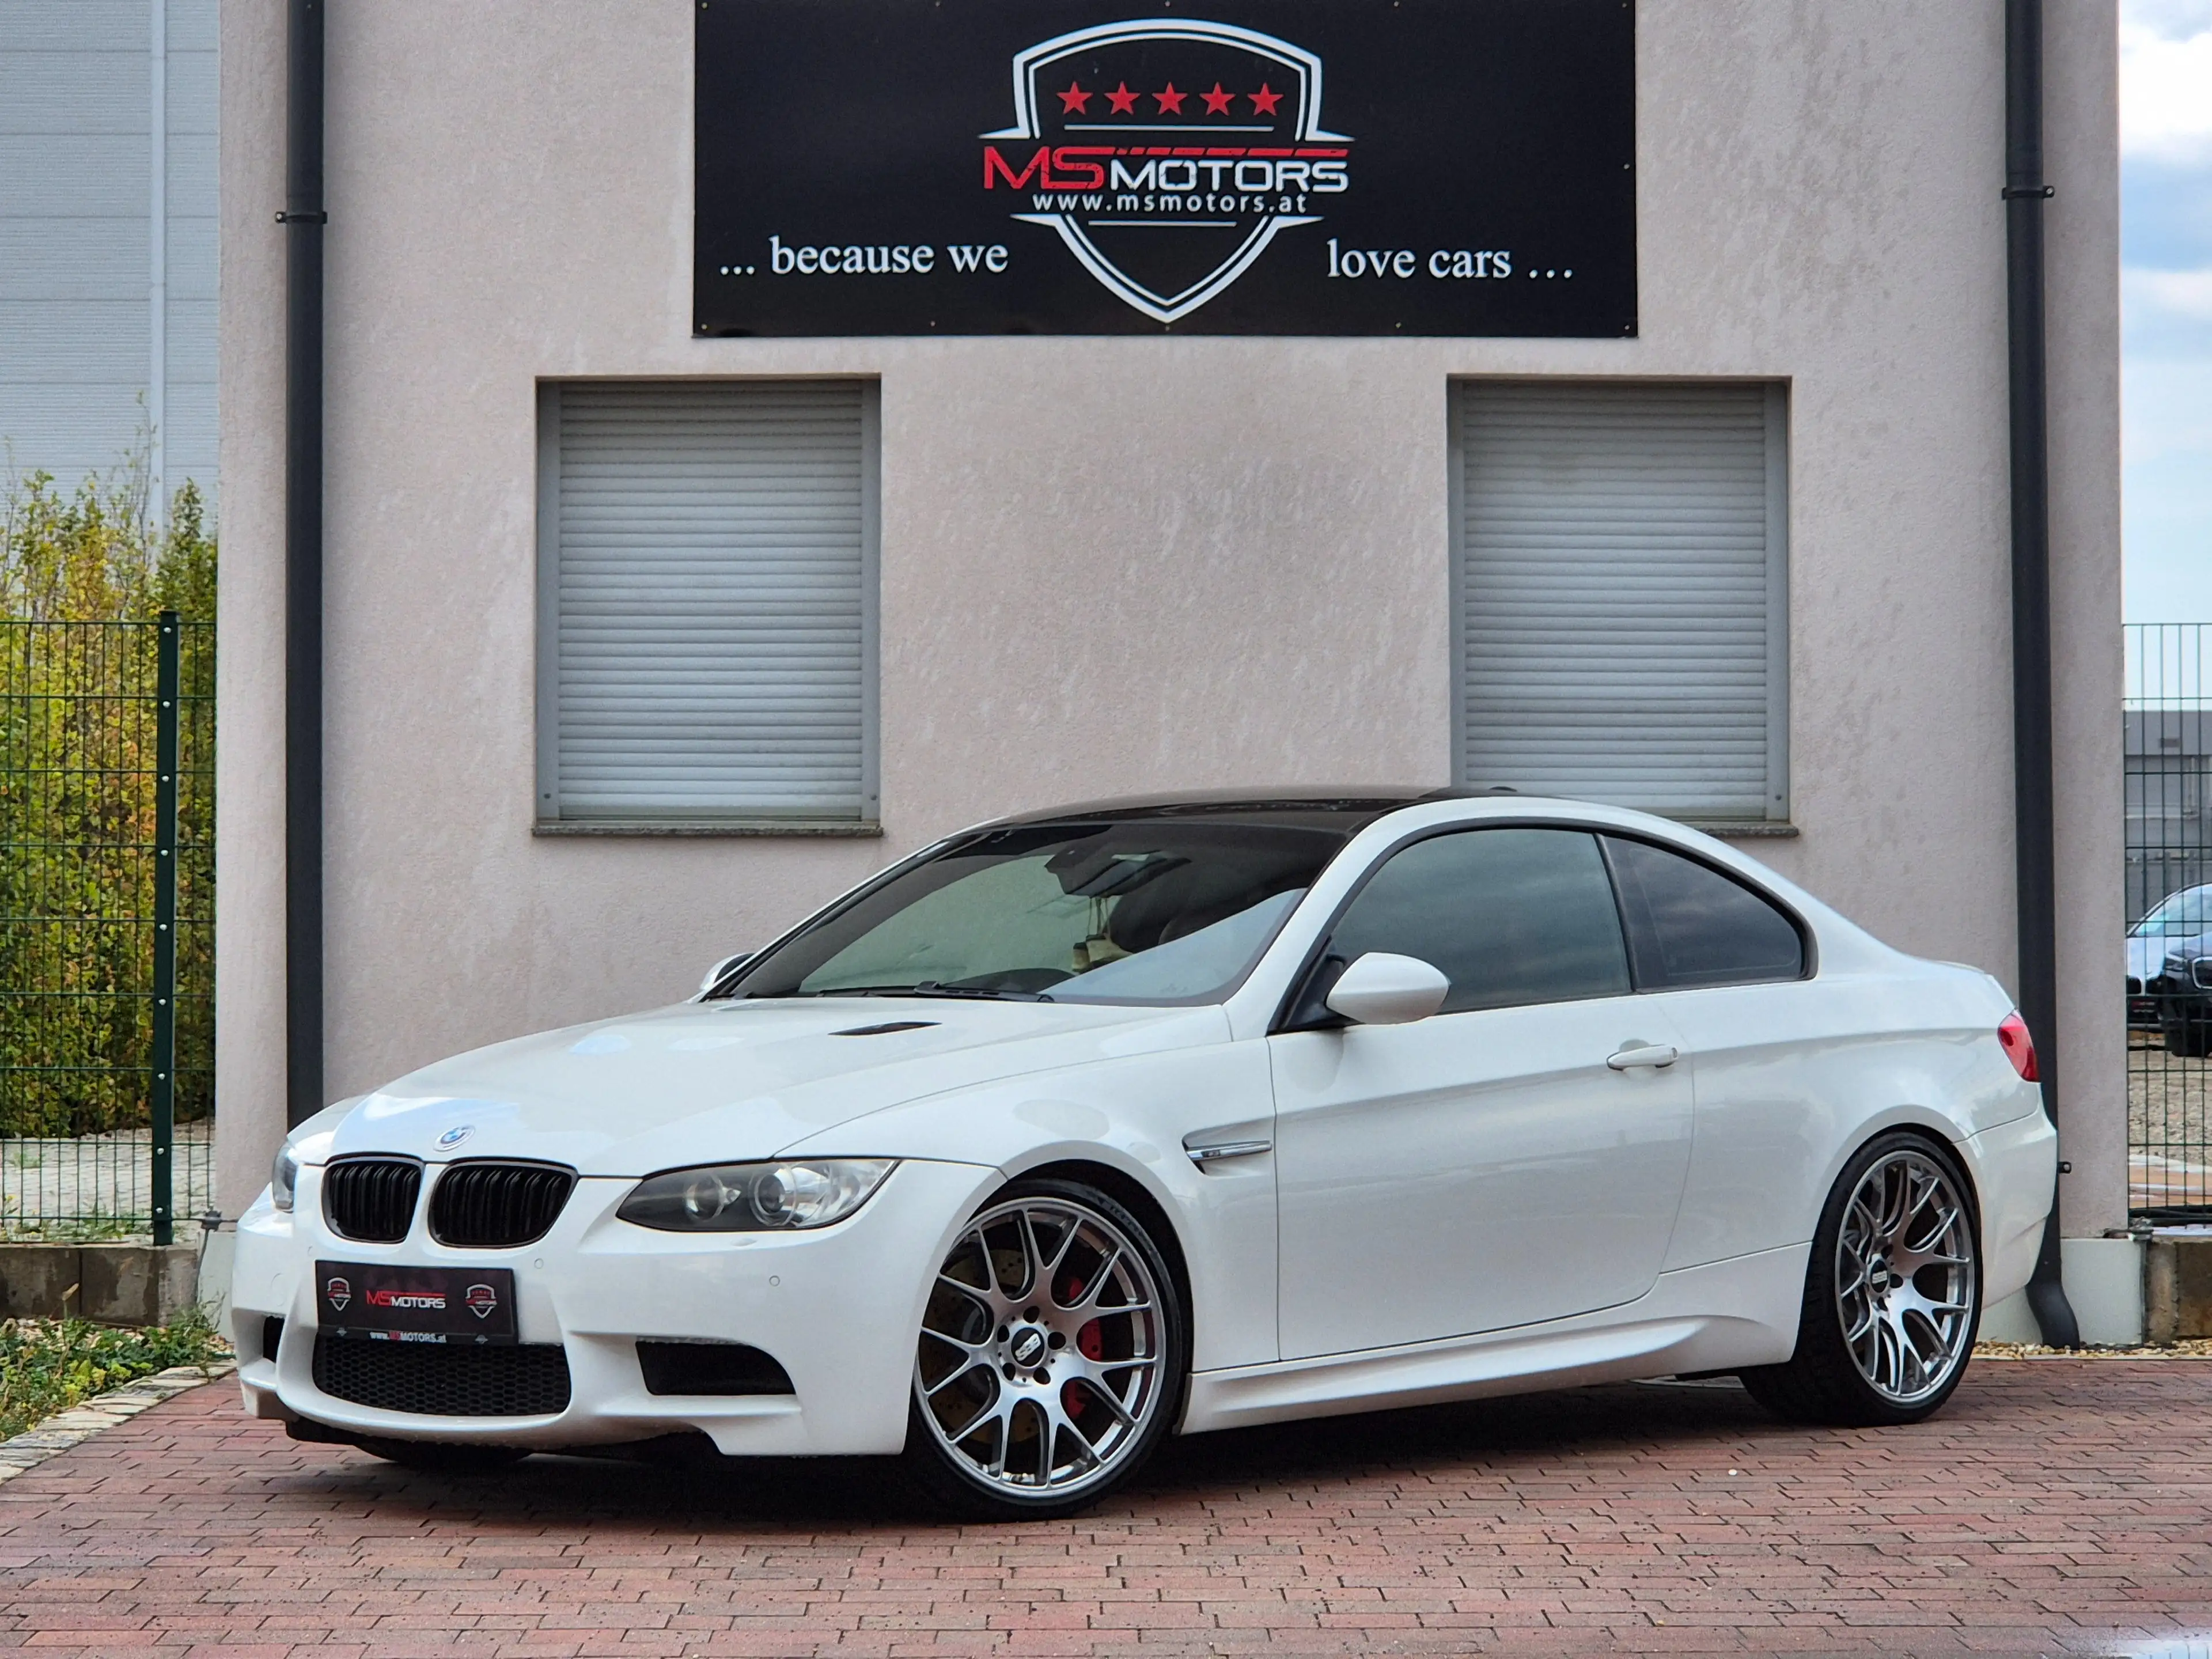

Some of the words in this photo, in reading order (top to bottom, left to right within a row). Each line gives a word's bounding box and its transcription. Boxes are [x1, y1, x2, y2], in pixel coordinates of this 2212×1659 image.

[1033, 193, 1307, 213] www.msmotors.at
[770, 236, 934, 274] because
[947, 245, 1009, 272] we
[1327, 238, 1416, 278] love
[1429, 251, 1512, 278] cars
